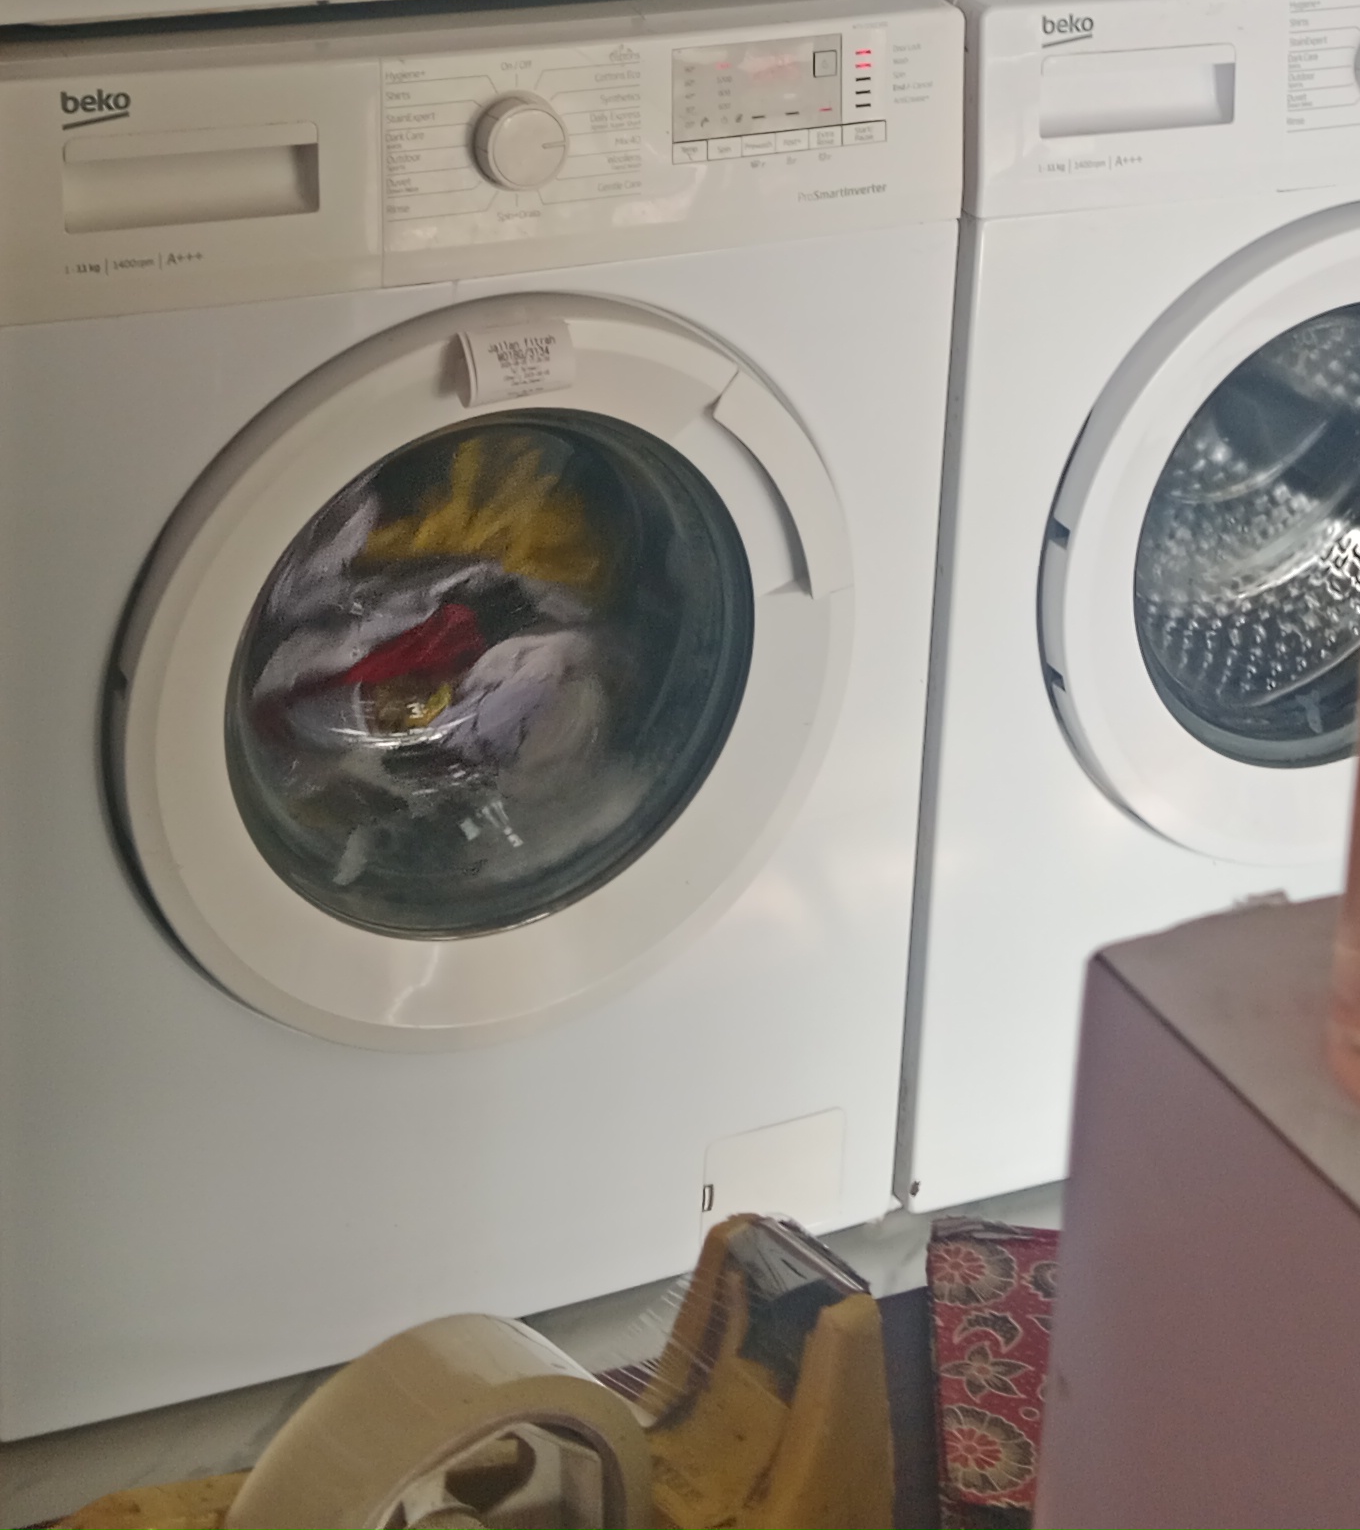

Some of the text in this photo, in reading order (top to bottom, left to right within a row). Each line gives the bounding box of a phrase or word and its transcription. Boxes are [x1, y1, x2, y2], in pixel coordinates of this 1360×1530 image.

[1041, 13, 1095, 35] beko
[60, 88, 132, 115] beko
[797, 183, 888, 203] ProSmartInverter
